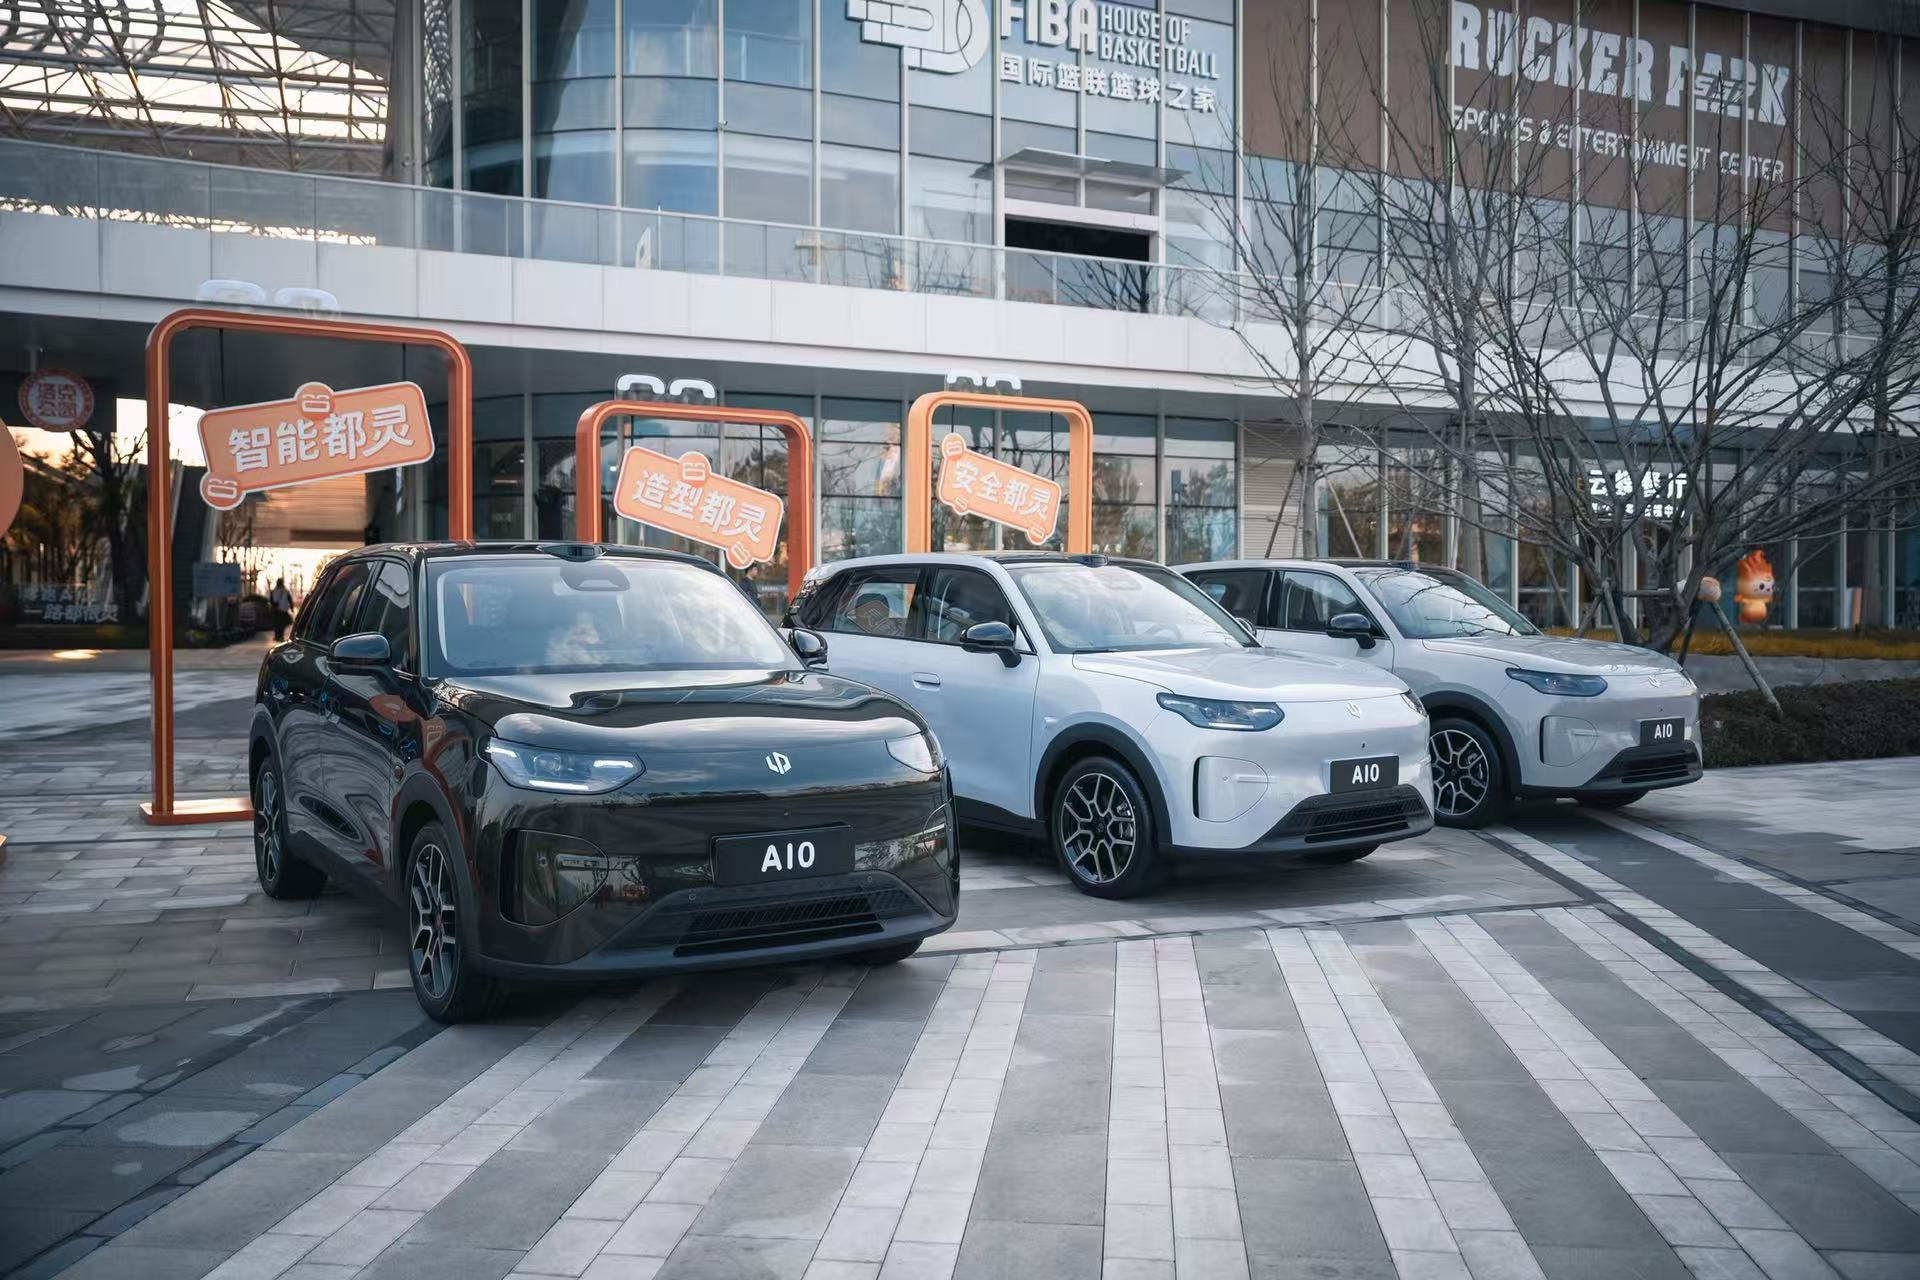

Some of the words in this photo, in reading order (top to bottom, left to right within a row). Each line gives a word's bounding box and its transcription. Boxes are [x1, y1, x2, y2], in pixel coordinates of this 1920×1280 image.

[1000, 0, 1099, 52] FIBA
[1101, 4, 1160, 40] HOUSE
[1168, 15, 1191, 44] OF
[1101, 33, 1220, 79] BASKETBALL
[1446, 0, 1654, 102] RUCKER
[1665, 44, 1790, 126] PARK
[1000, 52, 1216, 113] 国际篮联篮球之家
[1451, 103, 1534, 143] SPORS
[228, 404, 416, 473] 智能都灵
[632, 469, 767, 543] 造型都灵
[952, 460, 1051, 519] 安全都灵
[1654, 723, 1673, 739] A10
[1351, 763, 1379, 784] A10
[761, 841, 815, 873] A10
